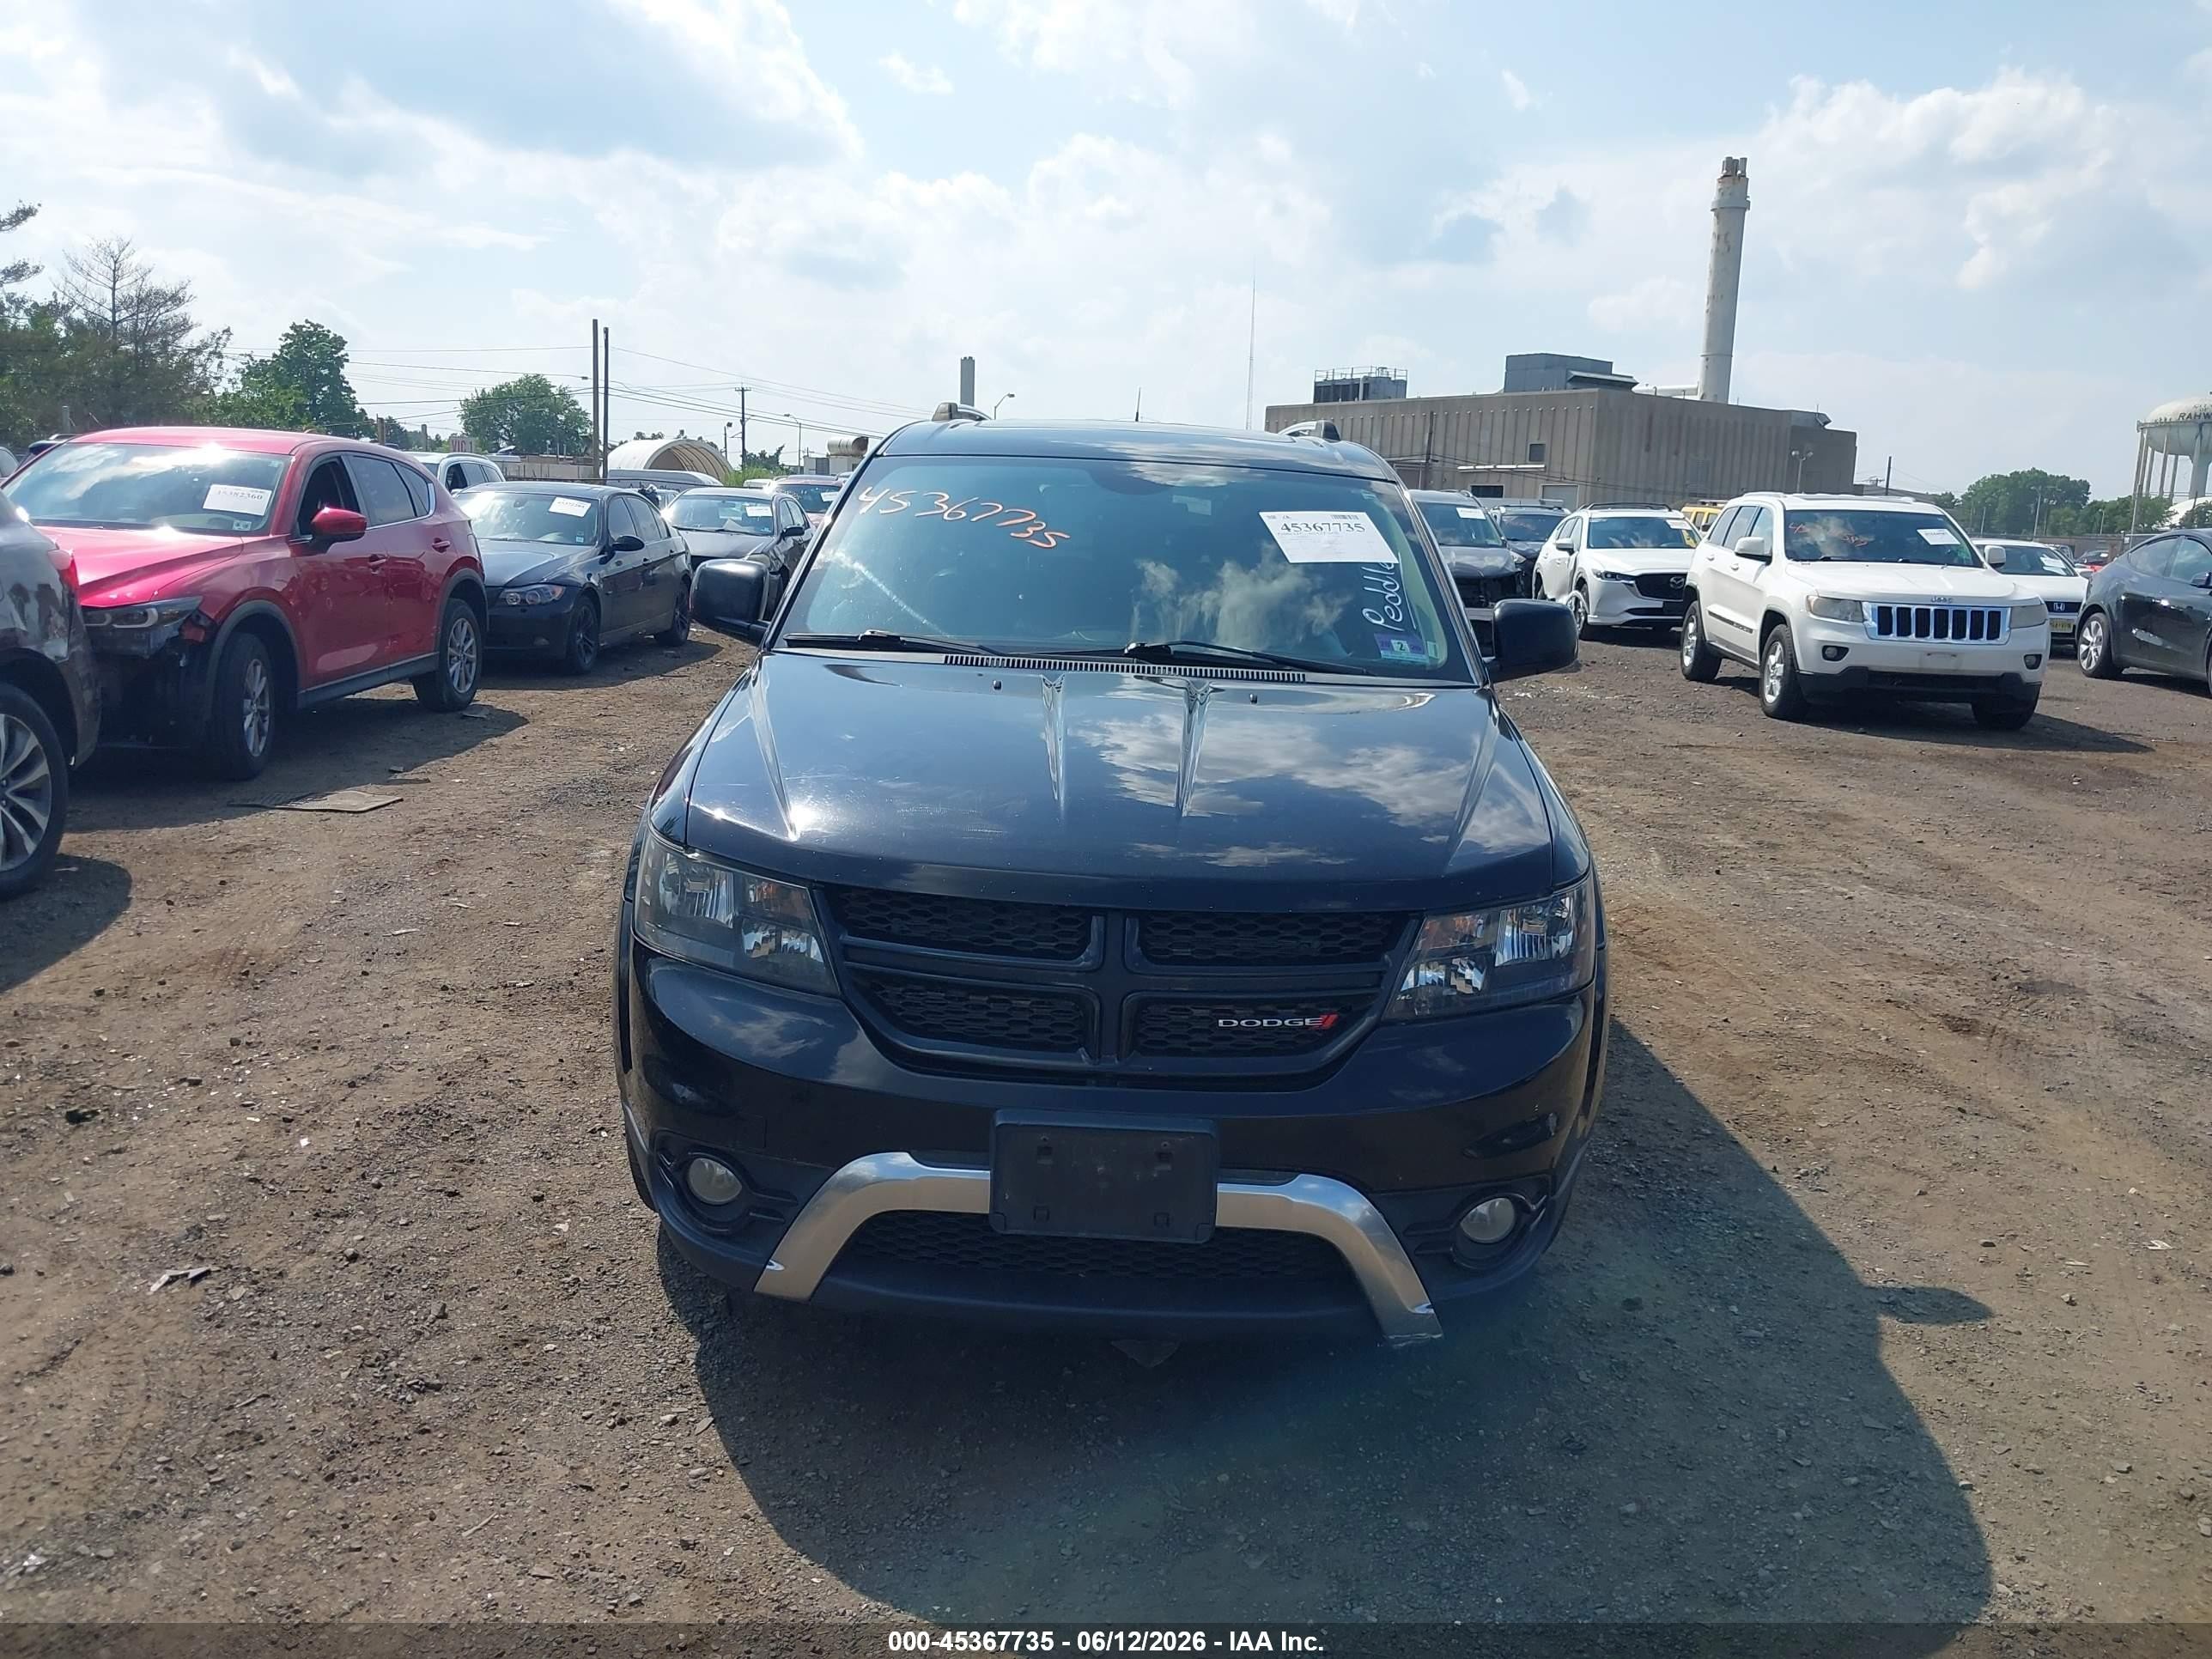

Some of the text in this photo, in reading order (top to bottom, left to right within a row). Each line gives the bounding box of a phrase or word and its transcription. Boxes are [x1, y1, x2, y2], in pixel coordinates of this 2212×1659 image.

[859, 487, 1071, 548] 45367735
[1280, 522, 1365, 532] 45367735
[1396, 641, 1406, 651] 2
[1218, 1018, 1323, 1027] DODGE
